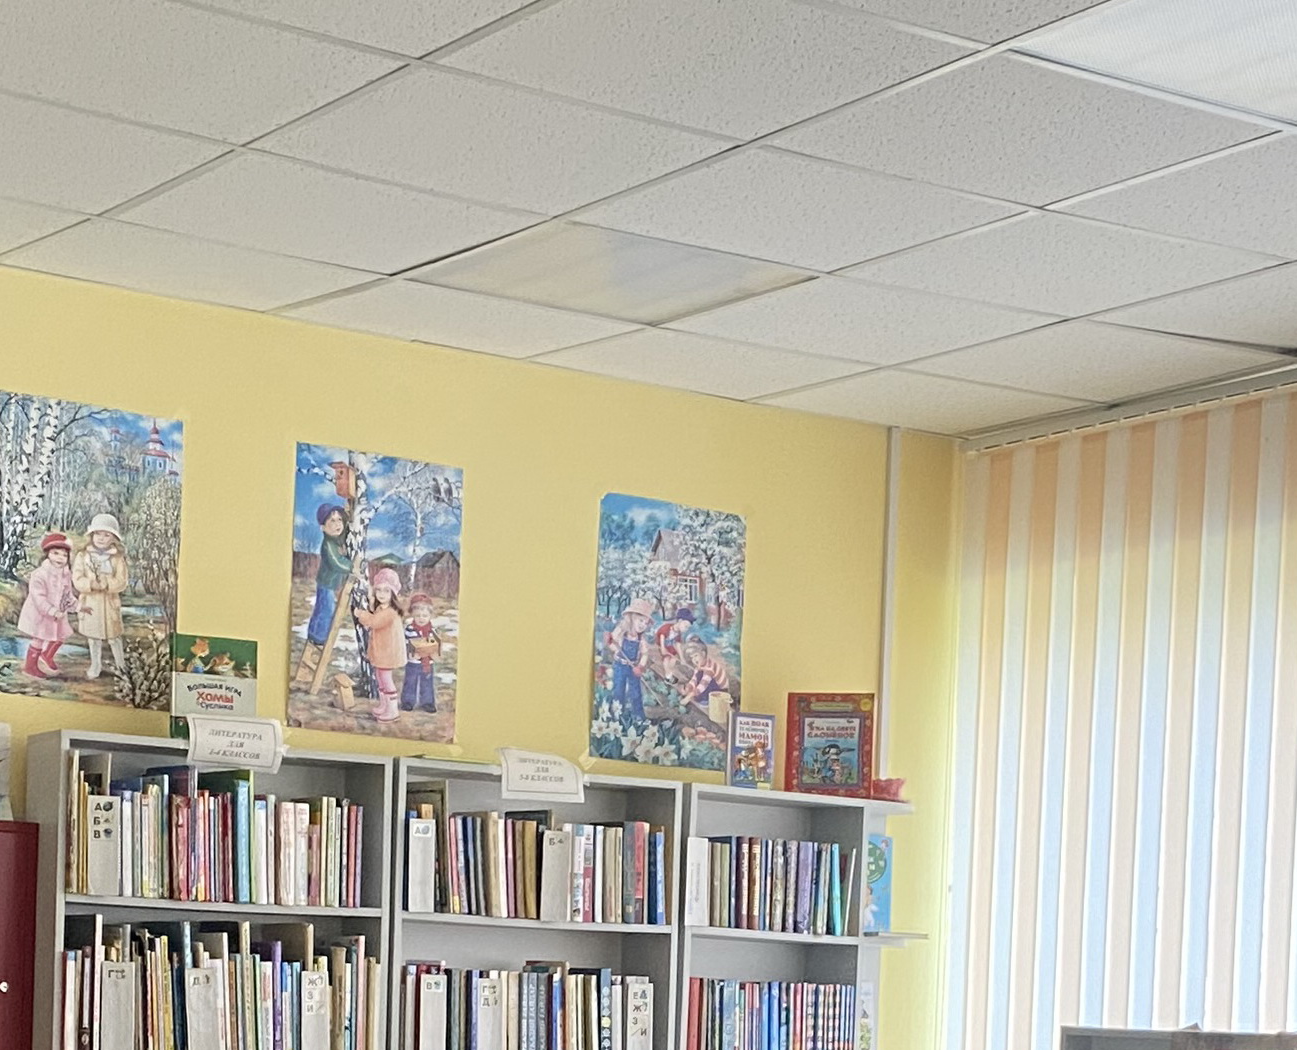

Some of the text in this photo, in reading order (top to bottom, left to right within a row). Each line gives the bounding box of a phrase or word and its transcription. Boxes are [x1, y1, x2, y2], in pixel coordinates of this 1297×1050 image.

[187, 683, 223, 692] БОЛЬШАЯ
[208, 729, 262, 741] ЛИТЕРАТУРА
[222, 750, 261, 760] КЛАССОВ
[94, 802, 102, 811] А
[93, 816, 101, 825] Б
[93, 830, 101, 838] В
